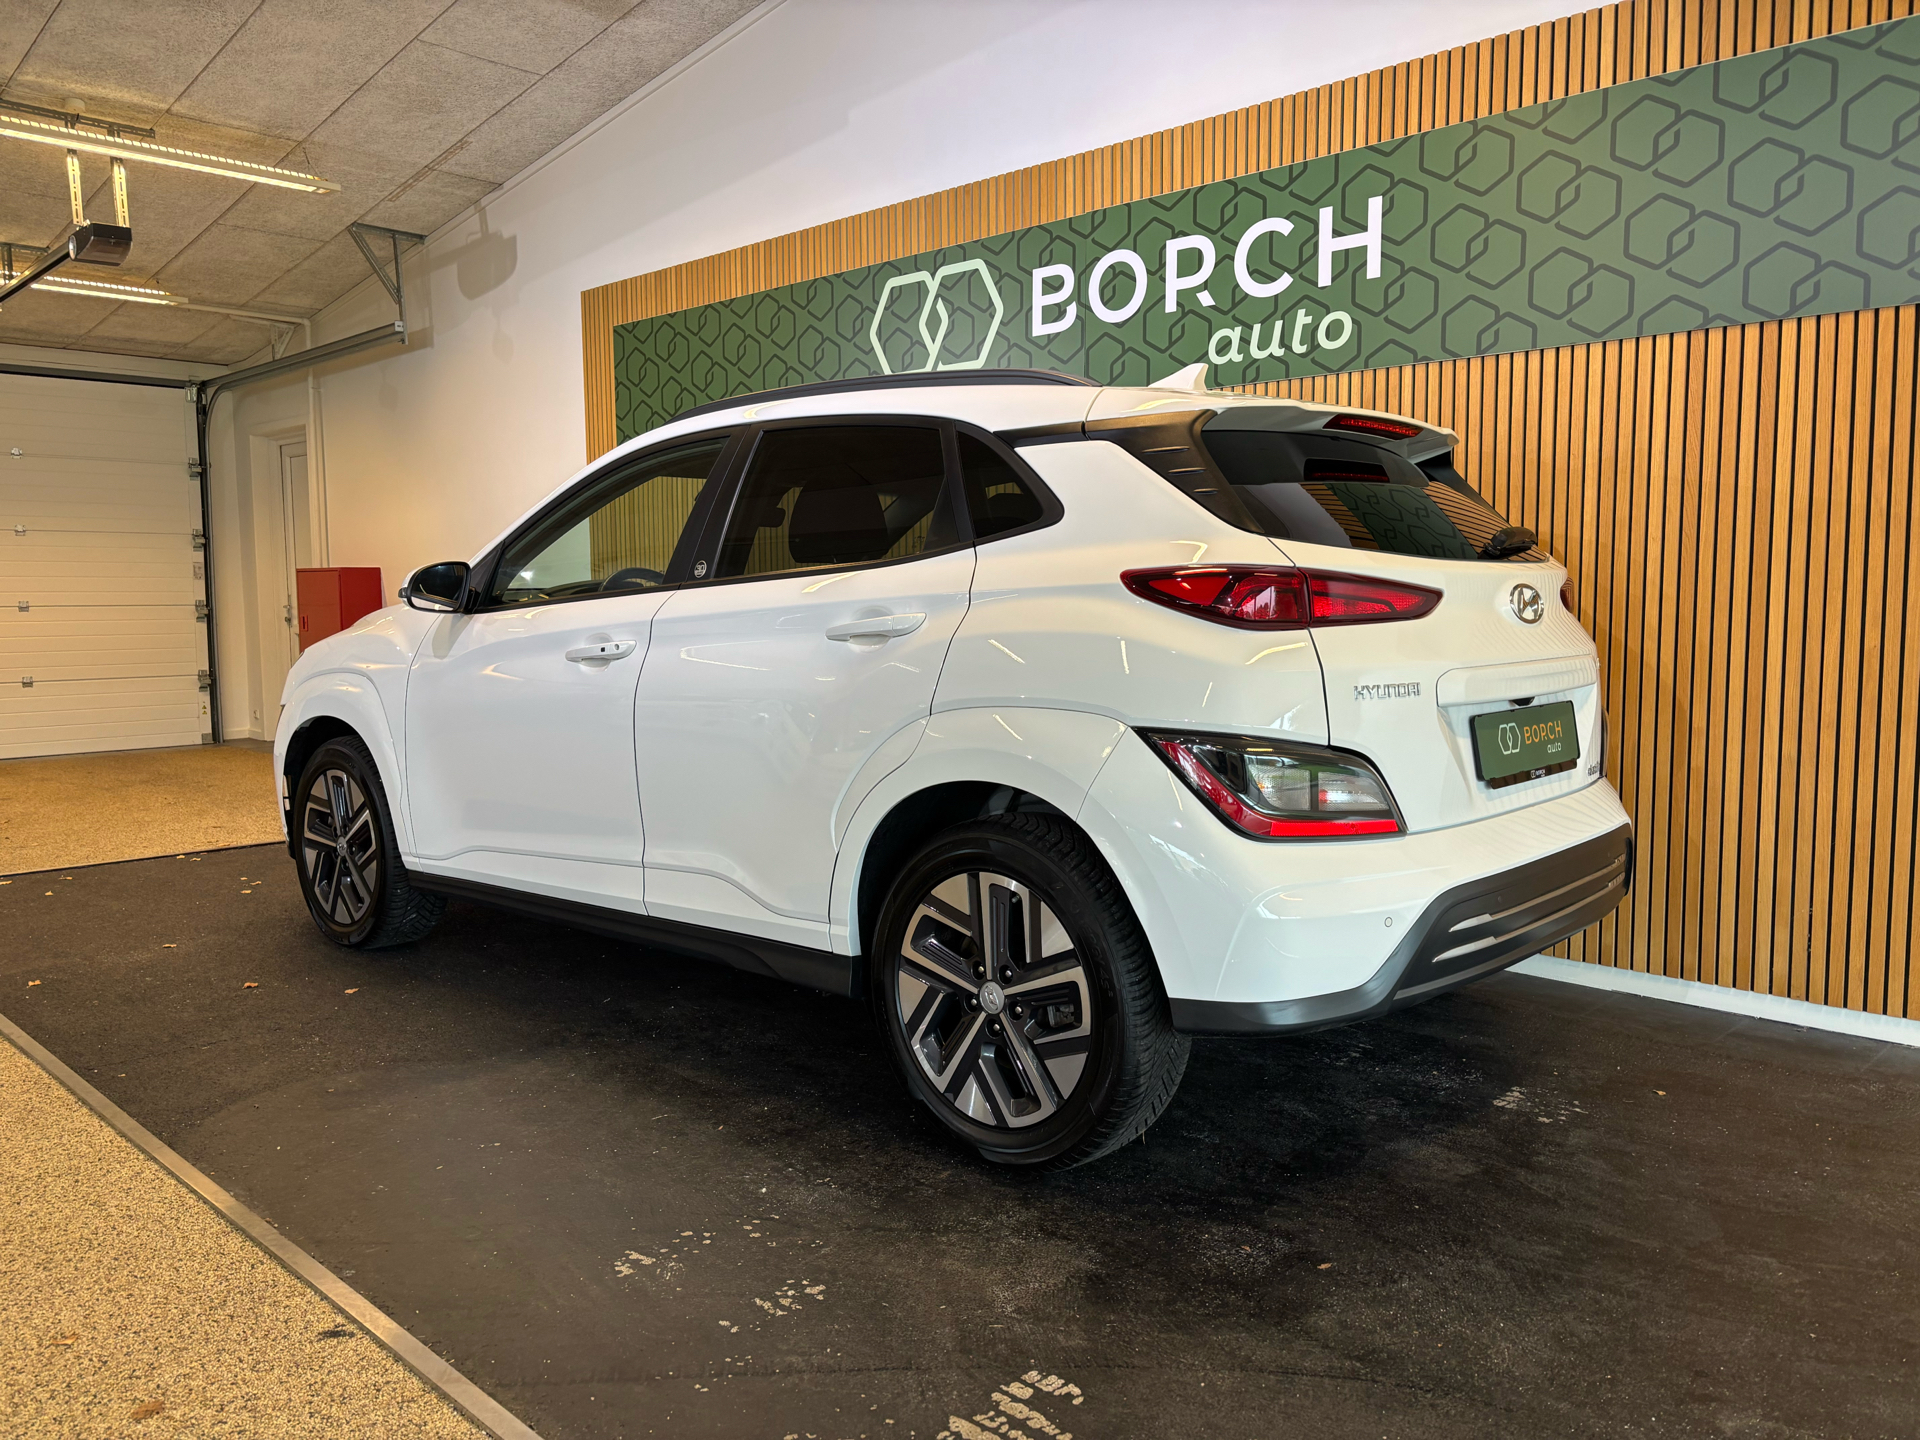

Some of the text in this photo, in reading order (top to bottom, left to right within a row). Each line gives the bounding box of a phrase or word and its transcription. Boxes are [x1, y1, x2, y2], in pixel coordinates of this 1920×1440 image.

[1032, 196, 1383, 337] BORCH
[1207, 308, 1352, 365] auto
[1354, 682, 1421, 700] HYUNDAI
[1523, 720, 1563, 745] BORCH
[1547, 742, 1562, 753] auto
